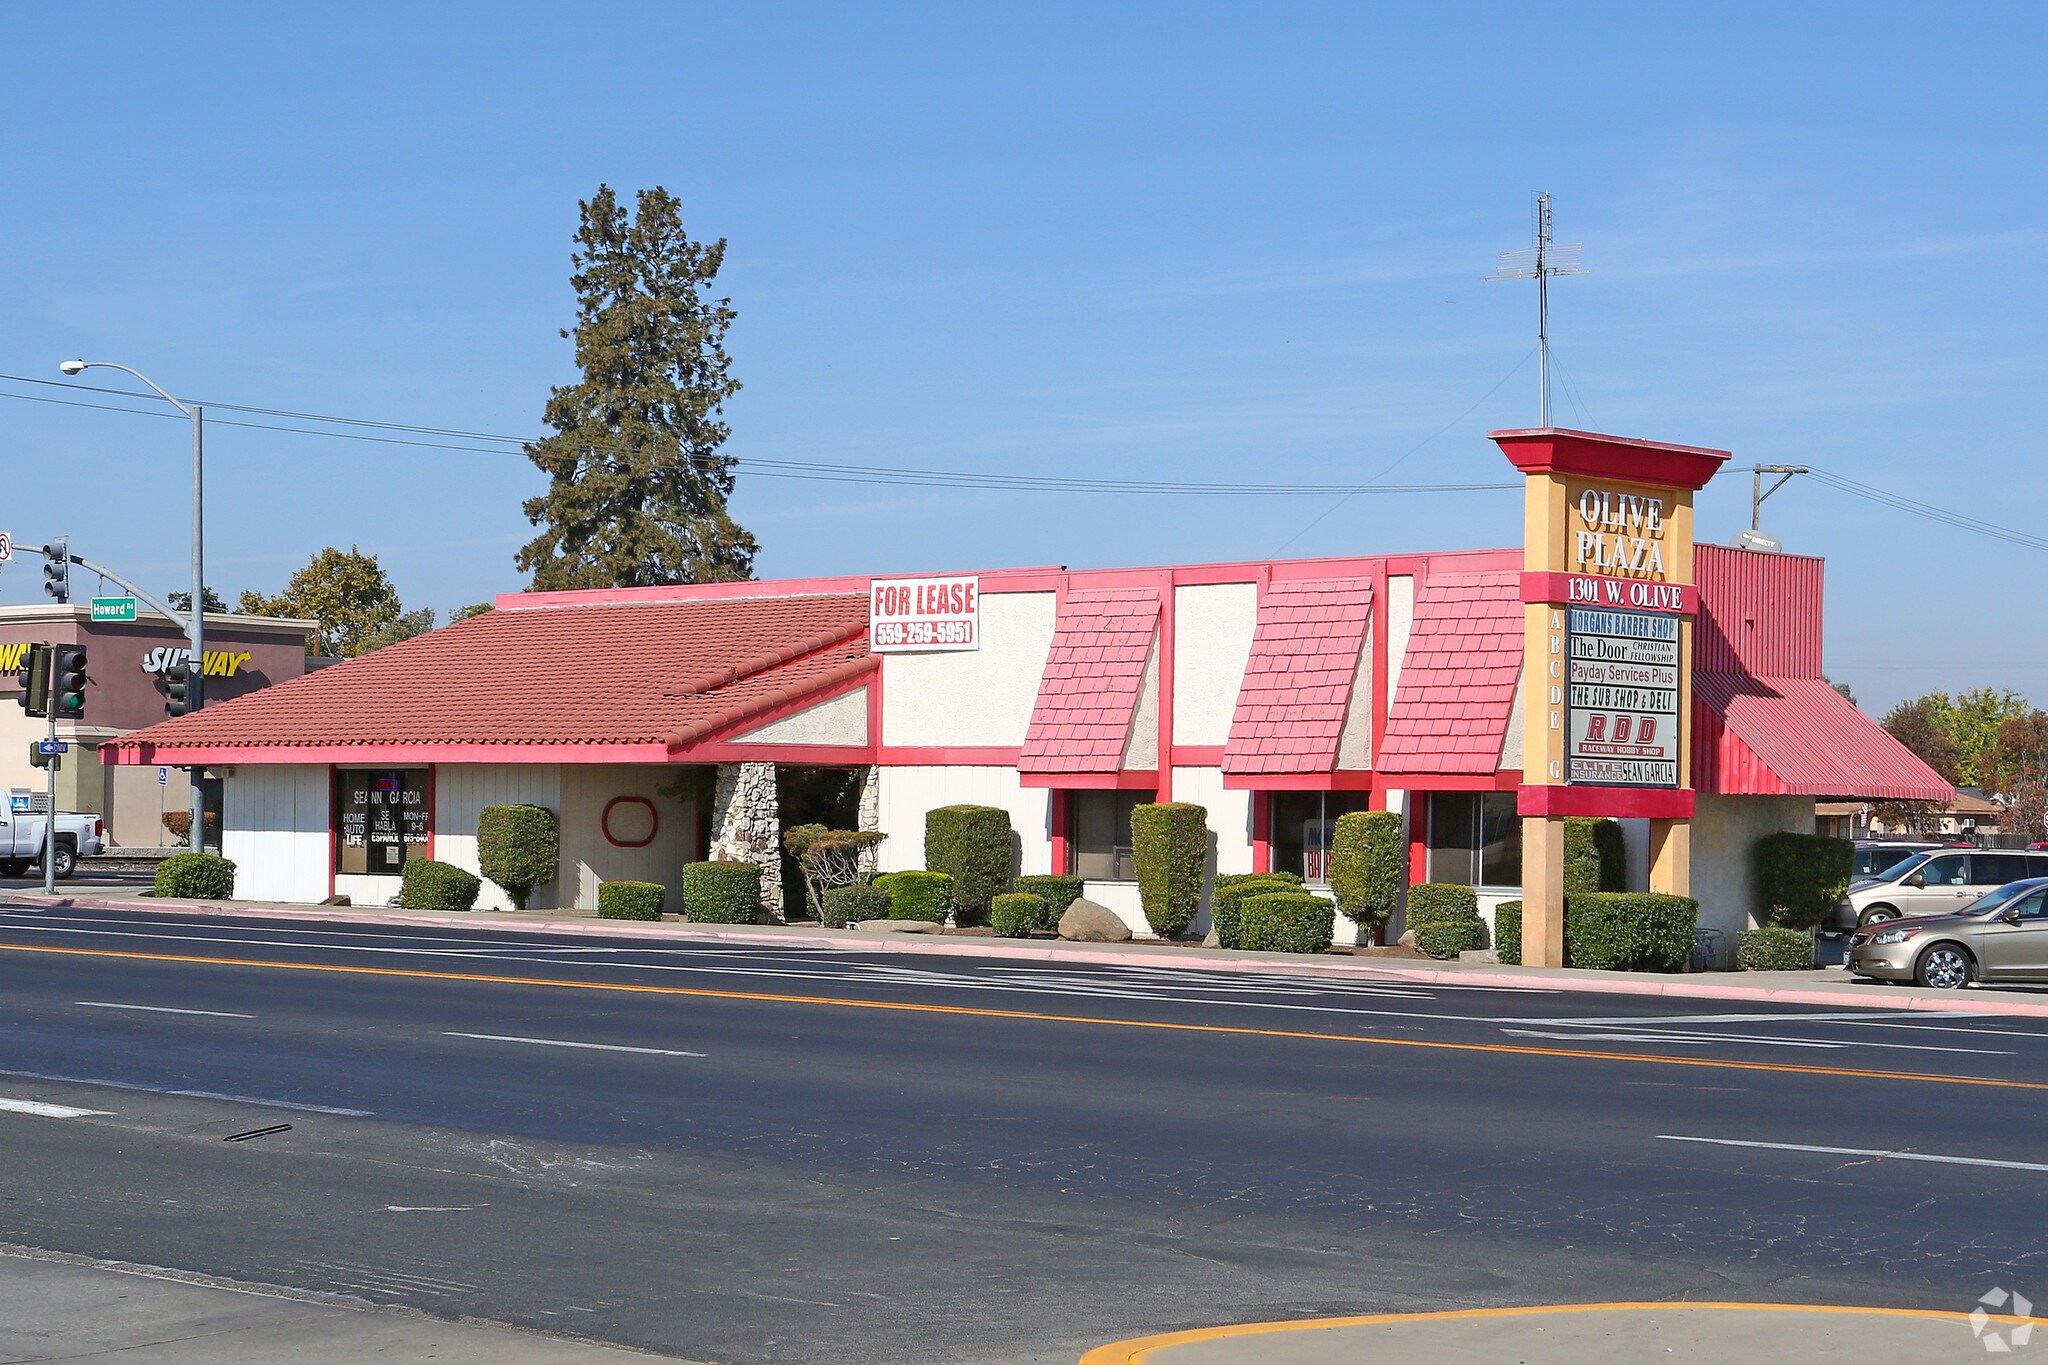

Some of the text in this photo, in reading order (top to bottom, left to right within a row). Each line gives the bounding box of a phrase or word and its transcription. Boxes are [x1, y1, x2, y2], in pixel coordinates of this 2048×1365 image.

[1579, 488, 1663, 531] OLIVE
[1575, 530, 1665, 574] PLAZA
[875, 583, 975, 616] FOR LEASE
[1568, 577, 1683, 609] 1301 W. OLIVE
[93, 602, 134, 616] Howard Rd
[1550, 611, 1561, 630] A
[1571, 611, 1674, 639] MORGANS BARBER SHOP
[877, 621, 971, 645] 559-259-5951
[1550, 636, 1560, 654] B
[1571, 636, 1627, 660] The Door
[1632, 641, 1672, 652] CHRISTIAN
[1630, 651, 1674, 663] FELLOWSHIP
[1550, 660, 1561, 679] C
[1571, 661, 1674, 684] Payday Services Plus
[1550, 686, 1562, 705] D
[1571, 686, 1589, 705] THE
[1592, 688, 1611, 707] SUB
[1614, 690, 1639, 709] SHOP
[1649, 692, 1672, 711] DELI
[1550, 711, 1560, 730] E
[1582, 743, 1661, 756] RACEWAY HOBBY SHOP
[1549, 761, 1560, 779] G
[1571, 761, 1622, 772] ELITE
[1571, 769, 1623, 780] INSURANCE
[1622, 762, 1674, 783] SEAN GARCIA
[343, 813, 366, 823] HOME
[380, 810, 390, 820] SE
[345, 824, 365, 834] AUTO
[375, 821, 396, 831] HABLA
[411, 822, 424, 831] 9-6
[346, 834, 363, 846] LIFE
